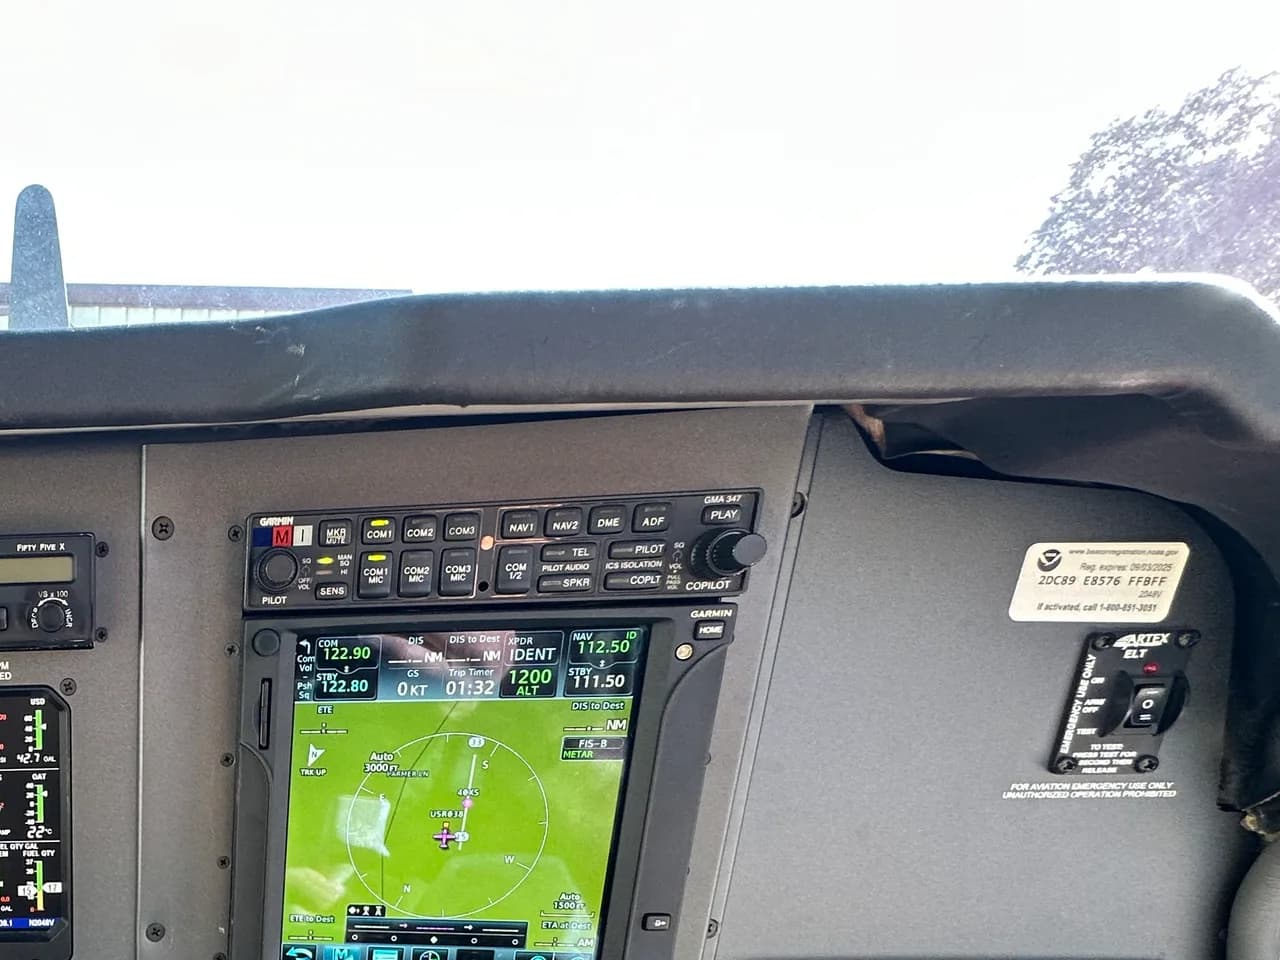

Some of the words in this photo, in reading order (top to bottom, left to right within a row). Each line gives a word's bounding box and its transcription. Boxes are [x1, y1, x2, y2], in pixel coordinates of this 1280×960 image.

[704, 495, 723, 503] GMA
[710, 510, 738, 519] PLAY
[259, 517, 294, 526] GARMIN
[552, 521, 578, 530] NAV2
[597, 517, 620, 527] DME
[642, 517, 665, 527] ADF
[448, 526, 475, 535] COM3
[509, 523, 534, 532] NAV1
[366, 530, 393, 539] COM1
[407, 528, 434, 537] COM2
[572, 548, 590, 556] TEL
[635, 544, 664, 554] PILOT
[562, 577, 590, 588] SPKR
[630, 576, 661, 585] COPLT
[1037, 576, 1076, 585] 2DC89
[1083, 576, 1120, 586] E8576
[685, 580, 732, 591] COPILOT
[320, 587, 345, 595] SENS
[262, 596, 288, 604] PILOT
[690, 610, 733, 618] GARMIN
[318, 640, 338, 648] COM
[508, 637, 533, 645] XPDR
[578, 640, 630, 654] 112.50
[324, 647, 371, 660] 122.90
[510, 648, 556, 661] IDENT
[1123, 649, 1148, 658] ELT
[316, 673, 338, 681] STBY
[407, 670, 419, 678] GS
[509, 669, 552, 685] 1200
[322, 680, 369, 692] 122.80
[574, 675, 625, 688] 111.50
[446, 680, 495, 695] 01:32
[516, 686, 539, 696] ALT
[17, 753, 40, 763] 42.7
[1010, 783, 1029, 791] FOR
[1072, 782, 1128, 790] EMERGENCY
[1122, 790, 1177, 798] PROHIBITED
